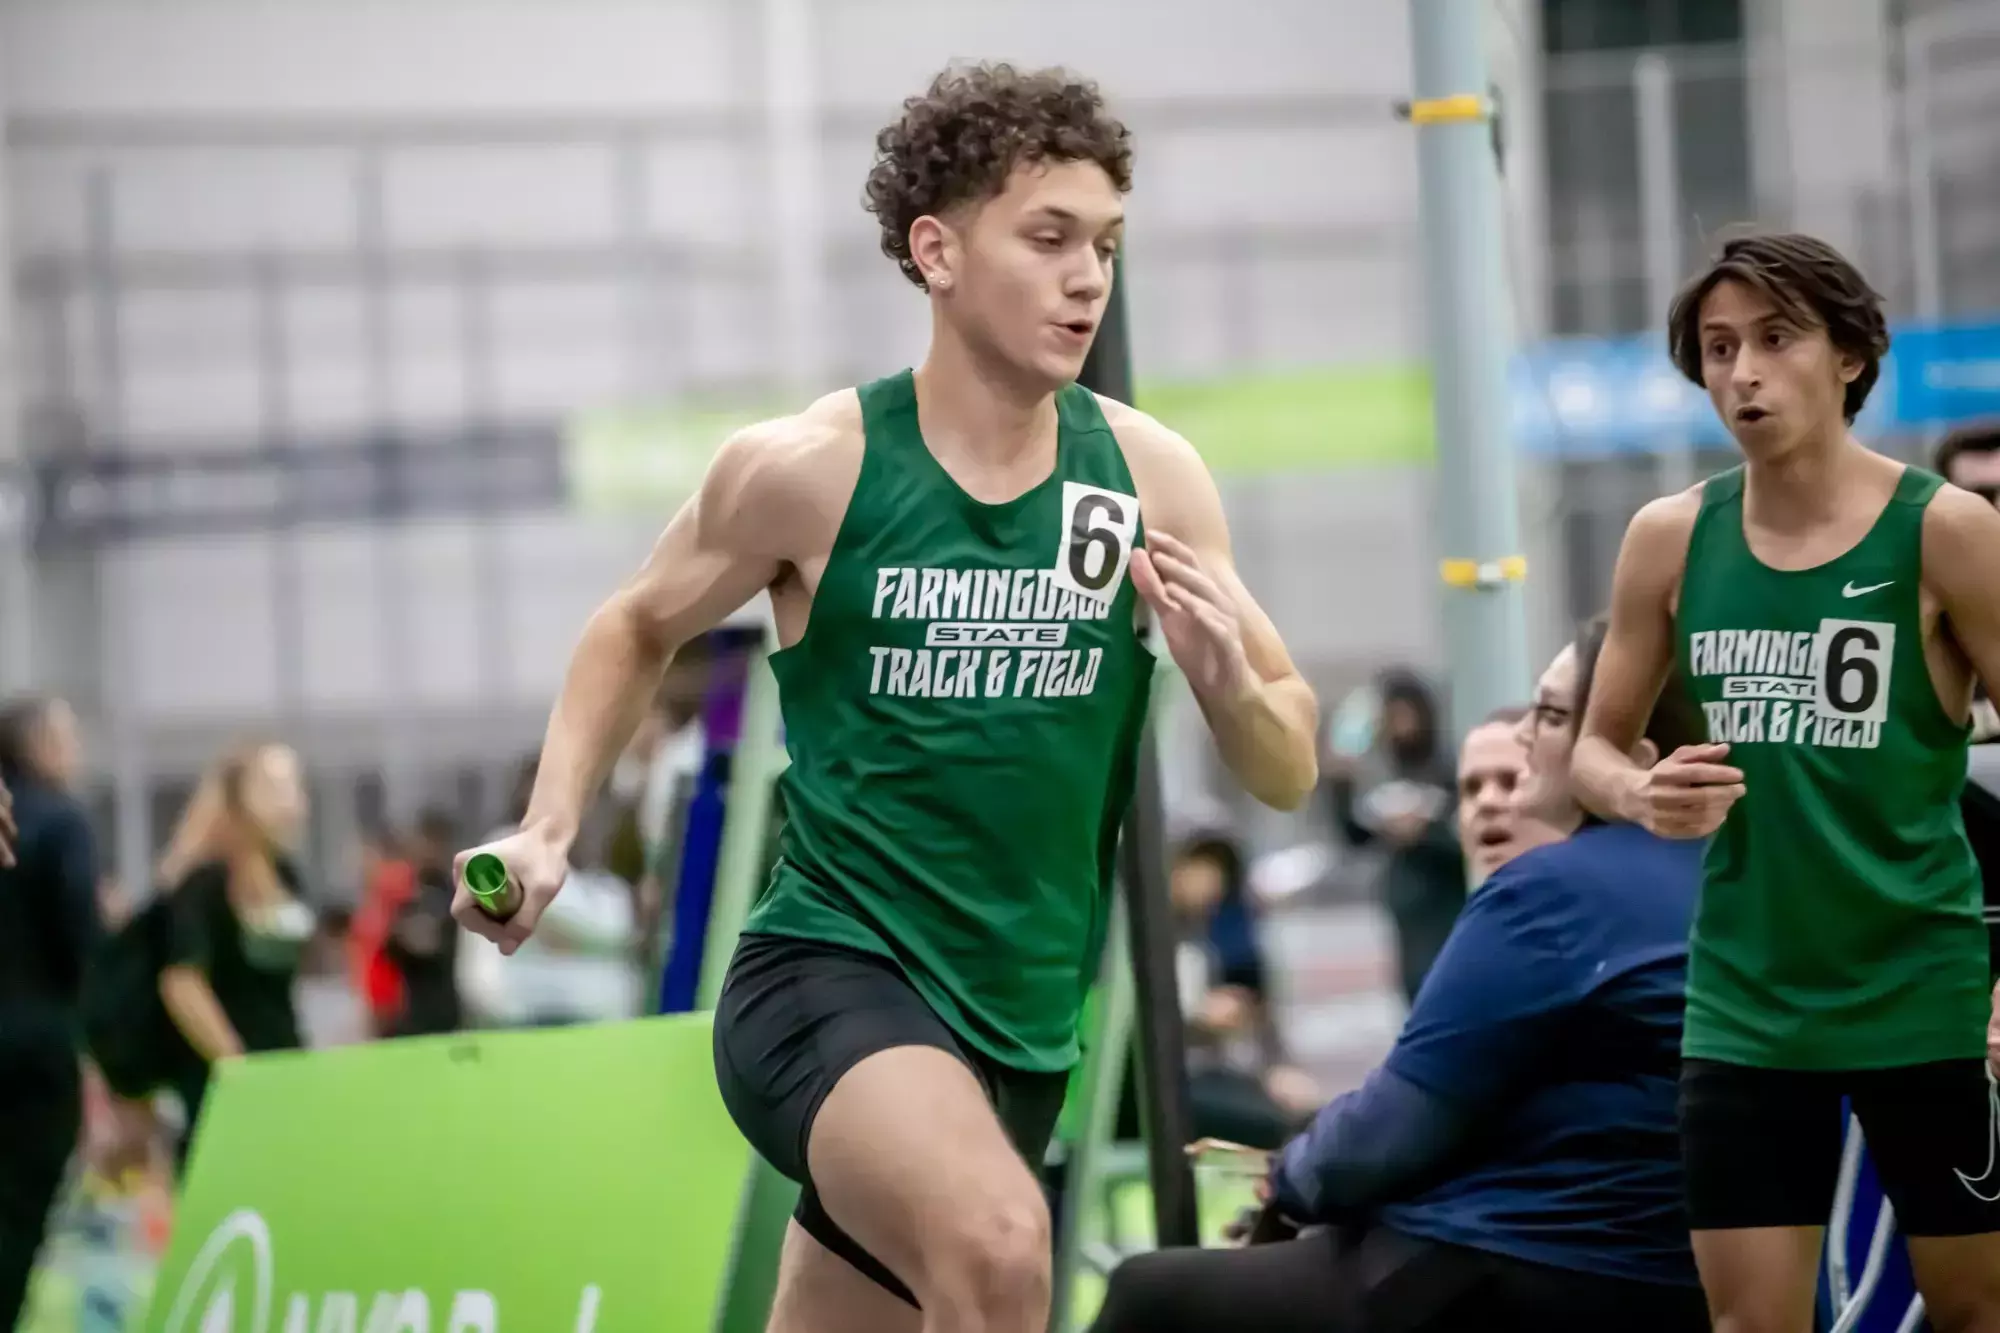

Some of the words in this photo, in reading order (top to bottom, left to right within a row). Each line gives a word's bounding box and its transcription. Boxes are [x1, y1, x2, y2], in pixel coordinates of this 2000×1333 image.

[1068, 494, 1125, 591] 6
[871, 567, 1110, 620] FARMINGDA
[934, 627, 1062, 642] STATE
[869, 646, 982, 698] TRACK
[984, 649, 1013, 698] &
[1013, 647, 1103, 698] FIELD
[1729, 681, 1816, 696] STAT
[1825, 627, 1881, 713] 6
[1701, 700, 1767, 744] RCK
[1767, 700, 1794, 743] &
